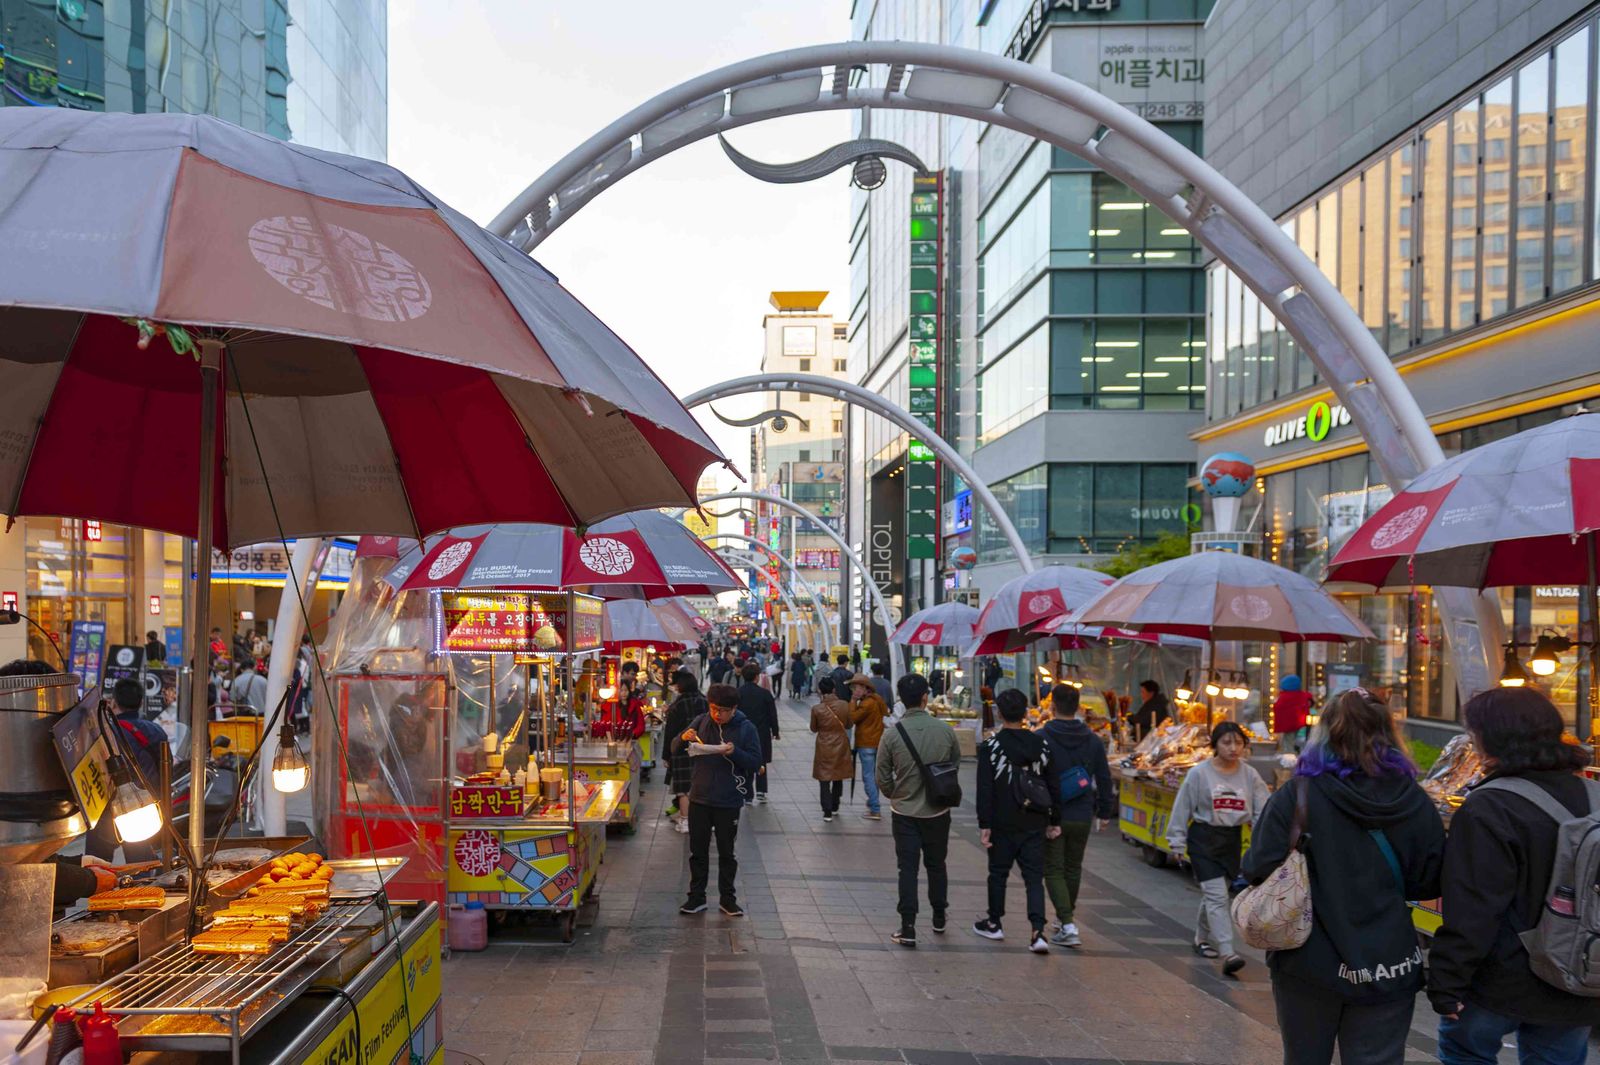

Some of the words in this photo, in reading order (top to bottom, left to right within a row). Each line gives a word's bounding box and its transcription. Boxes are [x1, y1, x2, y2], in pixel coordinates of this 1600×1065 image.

[1105, 44, 1134, 55] apple
[1264, 415, 1307, 448] OLIVE
[558, 877, 568, 887] 37
[365, 1033, 381, 1065] Film
